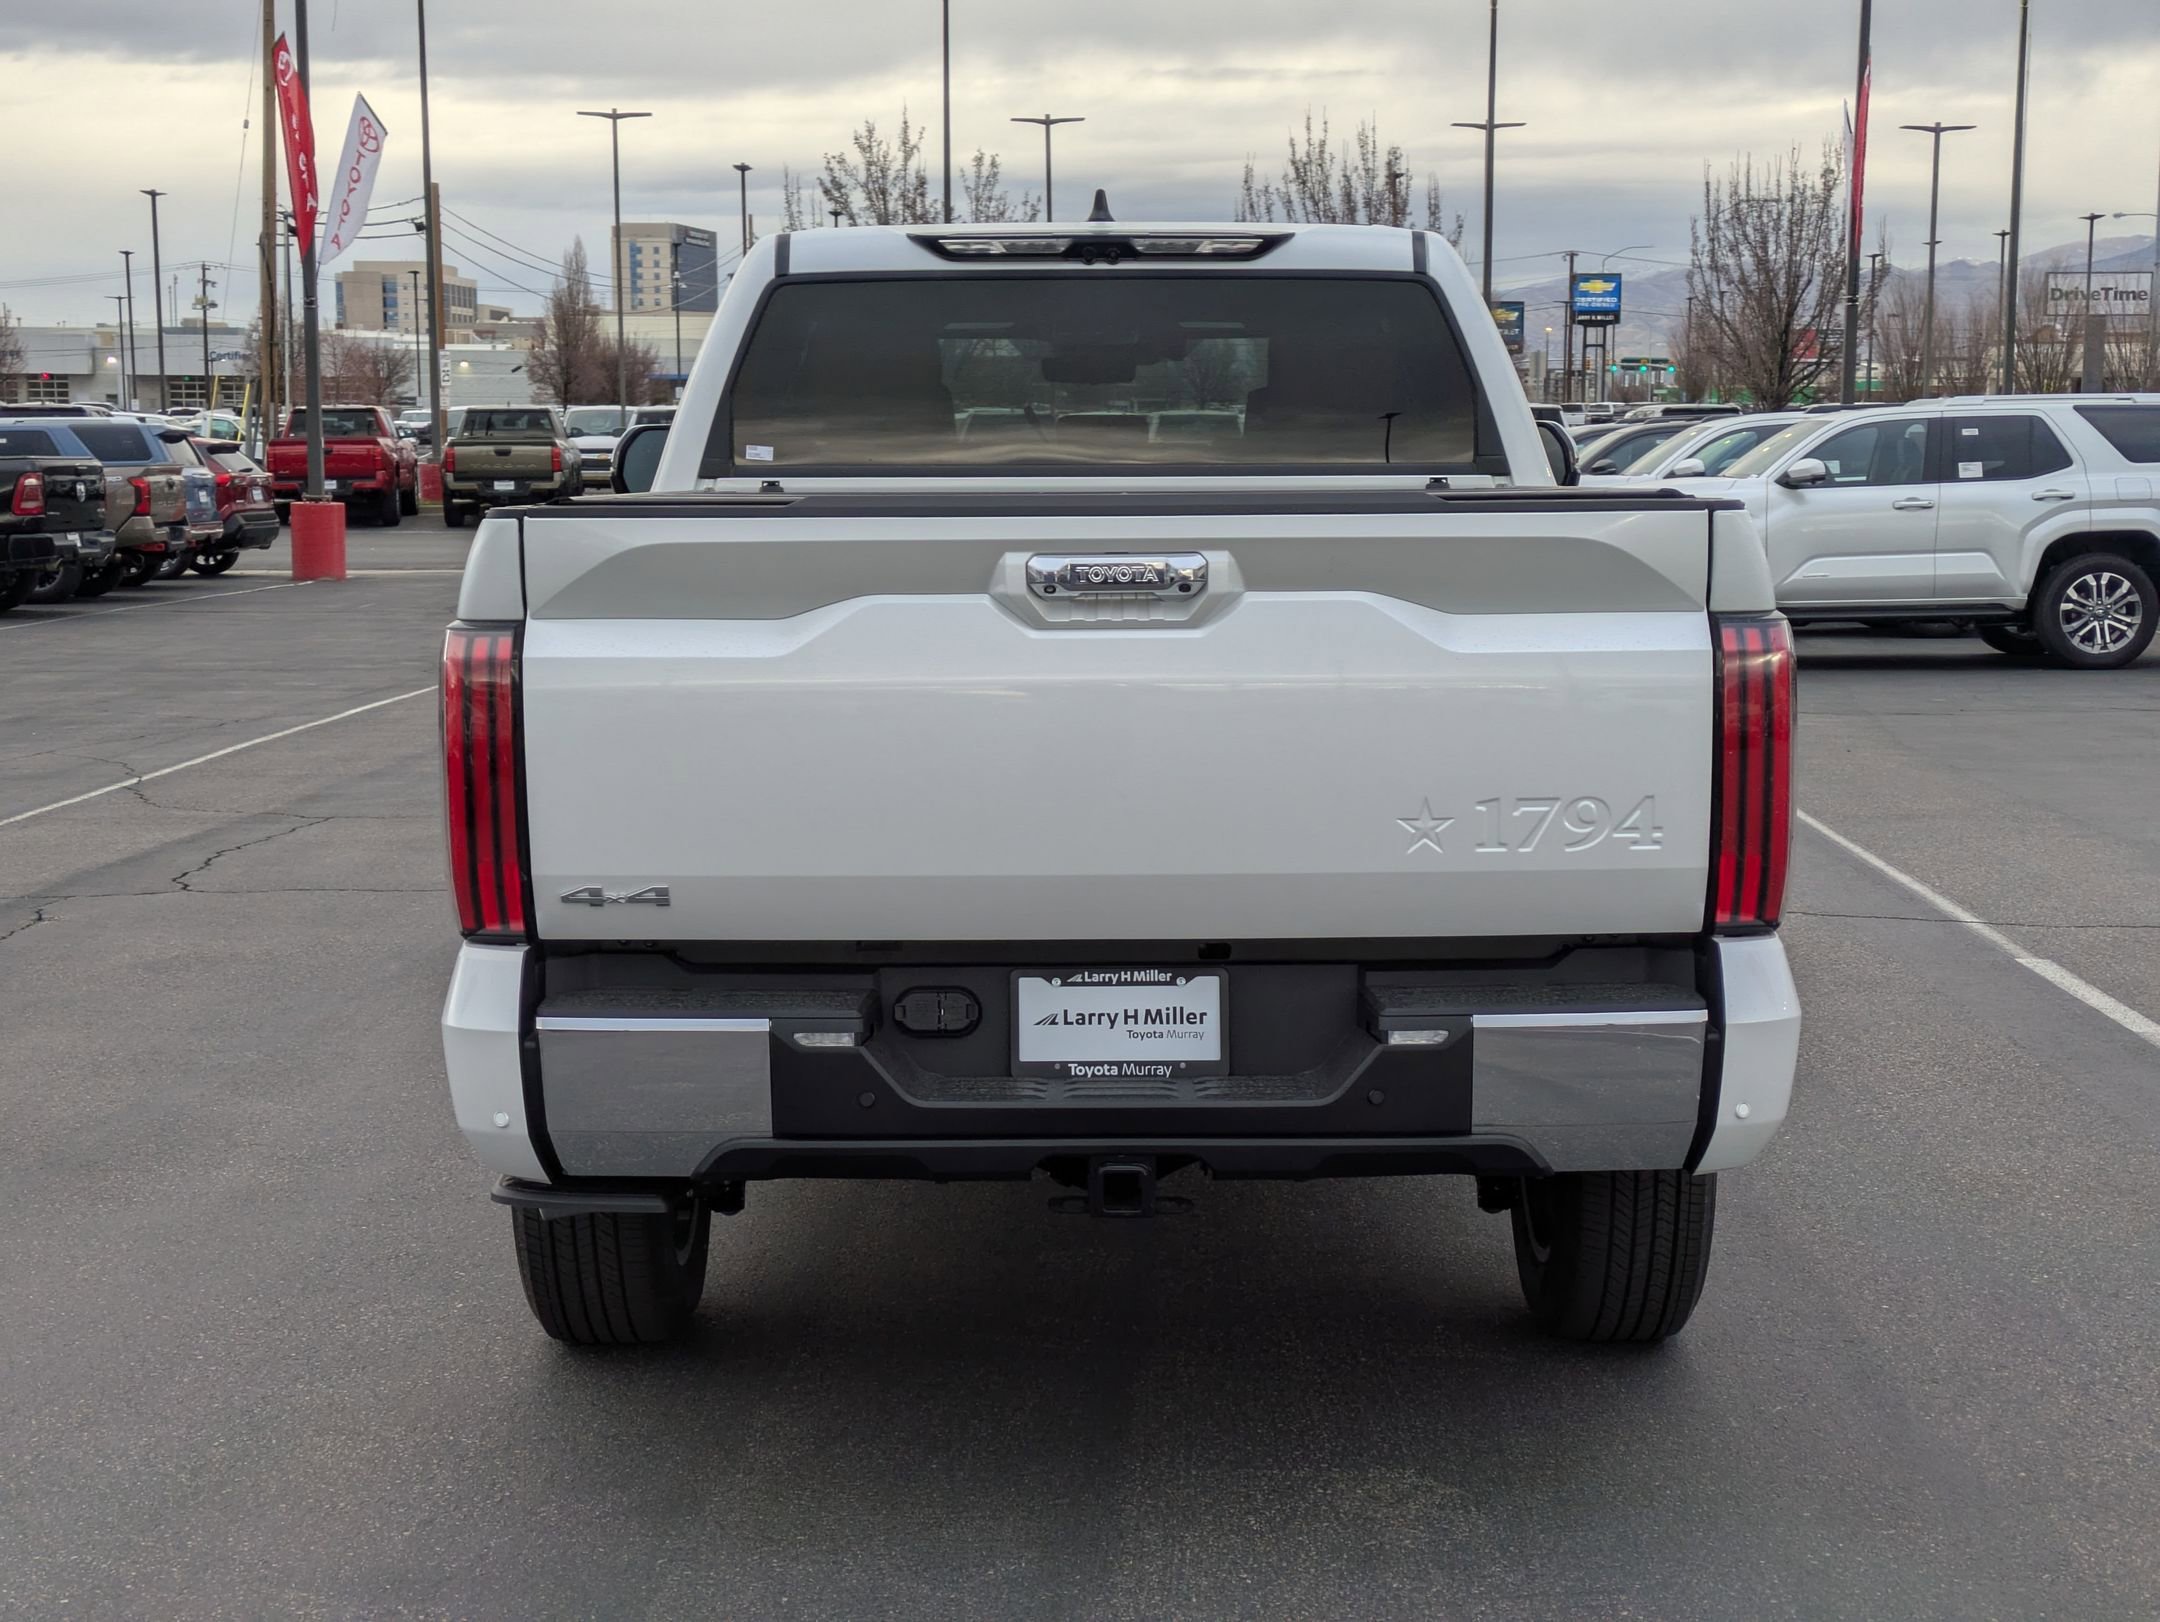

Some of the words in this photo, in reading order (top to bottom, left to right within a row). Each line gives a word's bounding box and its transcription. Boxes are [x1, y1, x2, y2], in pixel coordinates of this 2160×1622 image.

[330, 149, 366, 251] TOYOTA
[2050, 287, 2148, 301] DriveTime
[1075, 566, 1159, 583] TOYOTA
[1475, 795, 1664, 852] 1794
[1084, 971, 1119, 985] Larry
[1120, 971, 1131, 982] H
[1133, 969, 1172, 982] Miller
[1063, 1009, 1119, 1029] Larry
[1123, 1008, 1139, 1025] H
[1143, 1006, 1207, 1025] Miller
[1126, 1029, 1164, 1041] Toyota
[1166, 1029, 1205, 1041] Murray
[1068, 1063, 1119, 1078] Toyota
[1122, 1063, 1173, 1078] Murray
